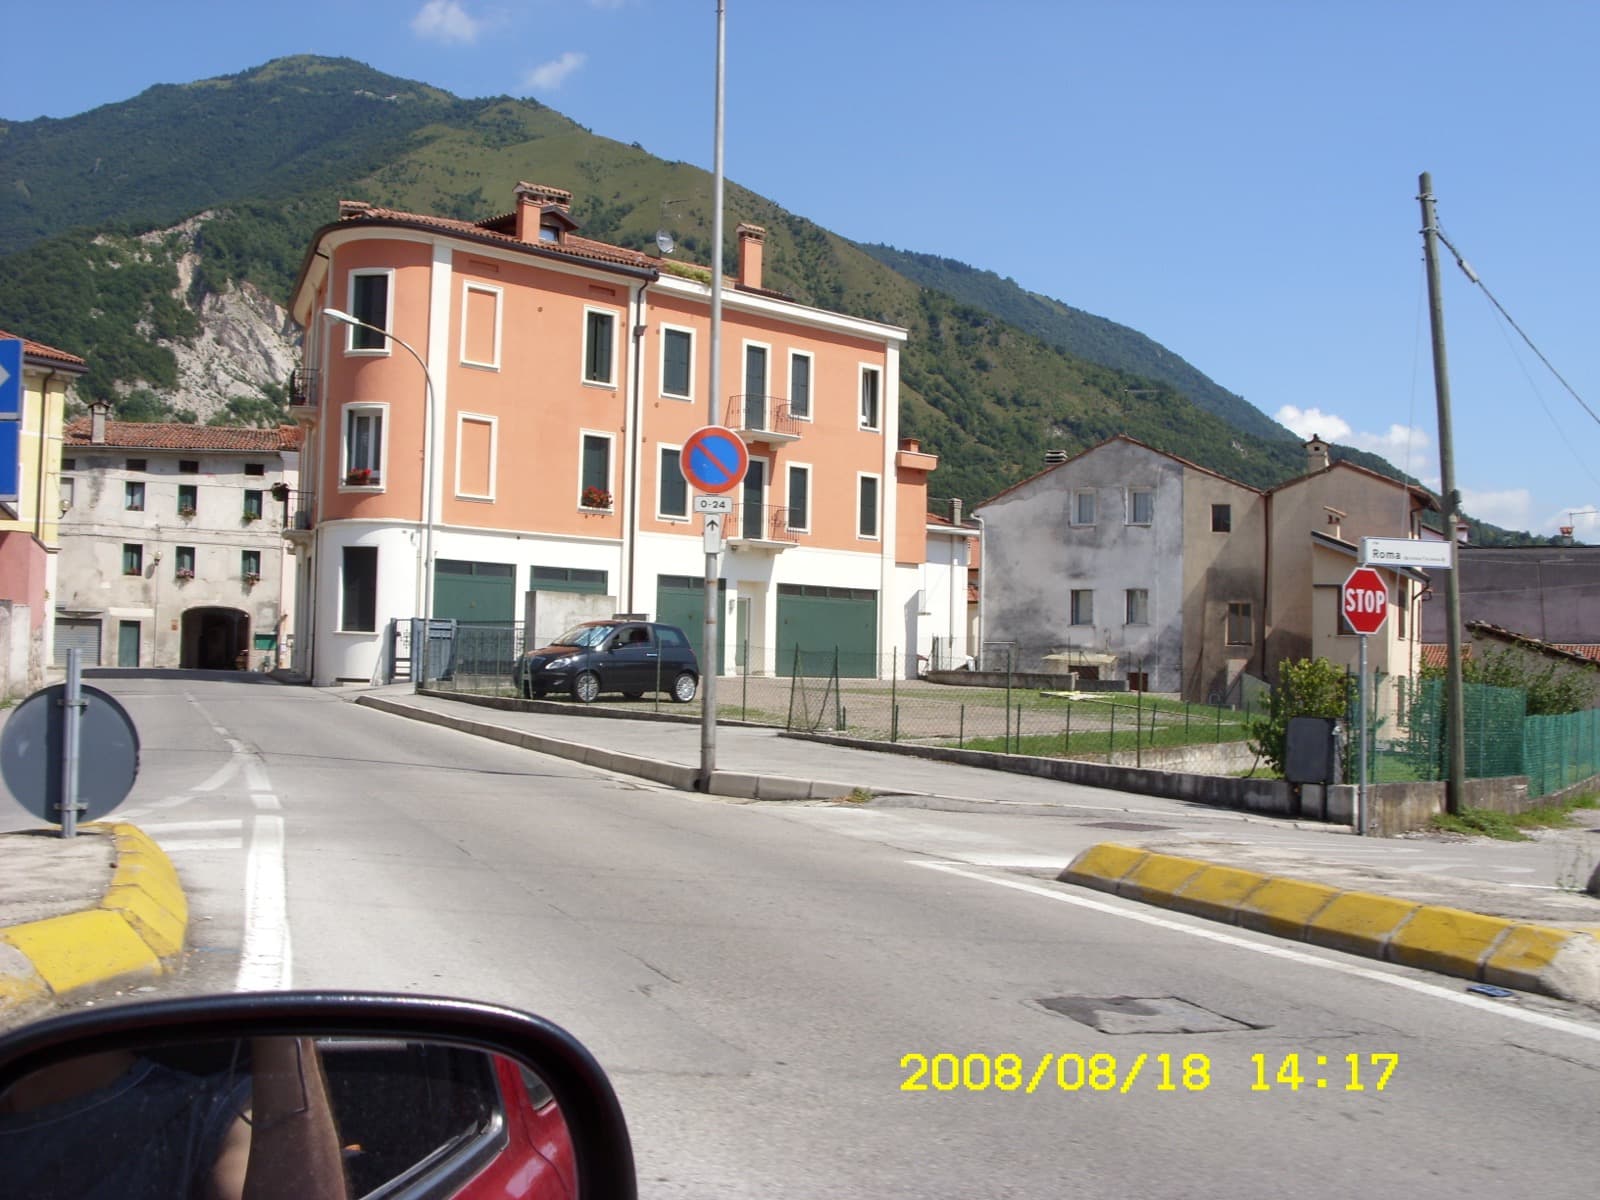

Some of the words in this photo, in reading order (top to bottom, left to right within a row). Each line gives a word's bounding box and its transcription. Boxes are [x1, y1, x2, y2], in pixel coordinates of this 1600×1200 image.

[700, 500, 726, 508] 0-24
[1372, 548, 1401, 559] Roma
[1345, 588, 1385, 613] STOP
